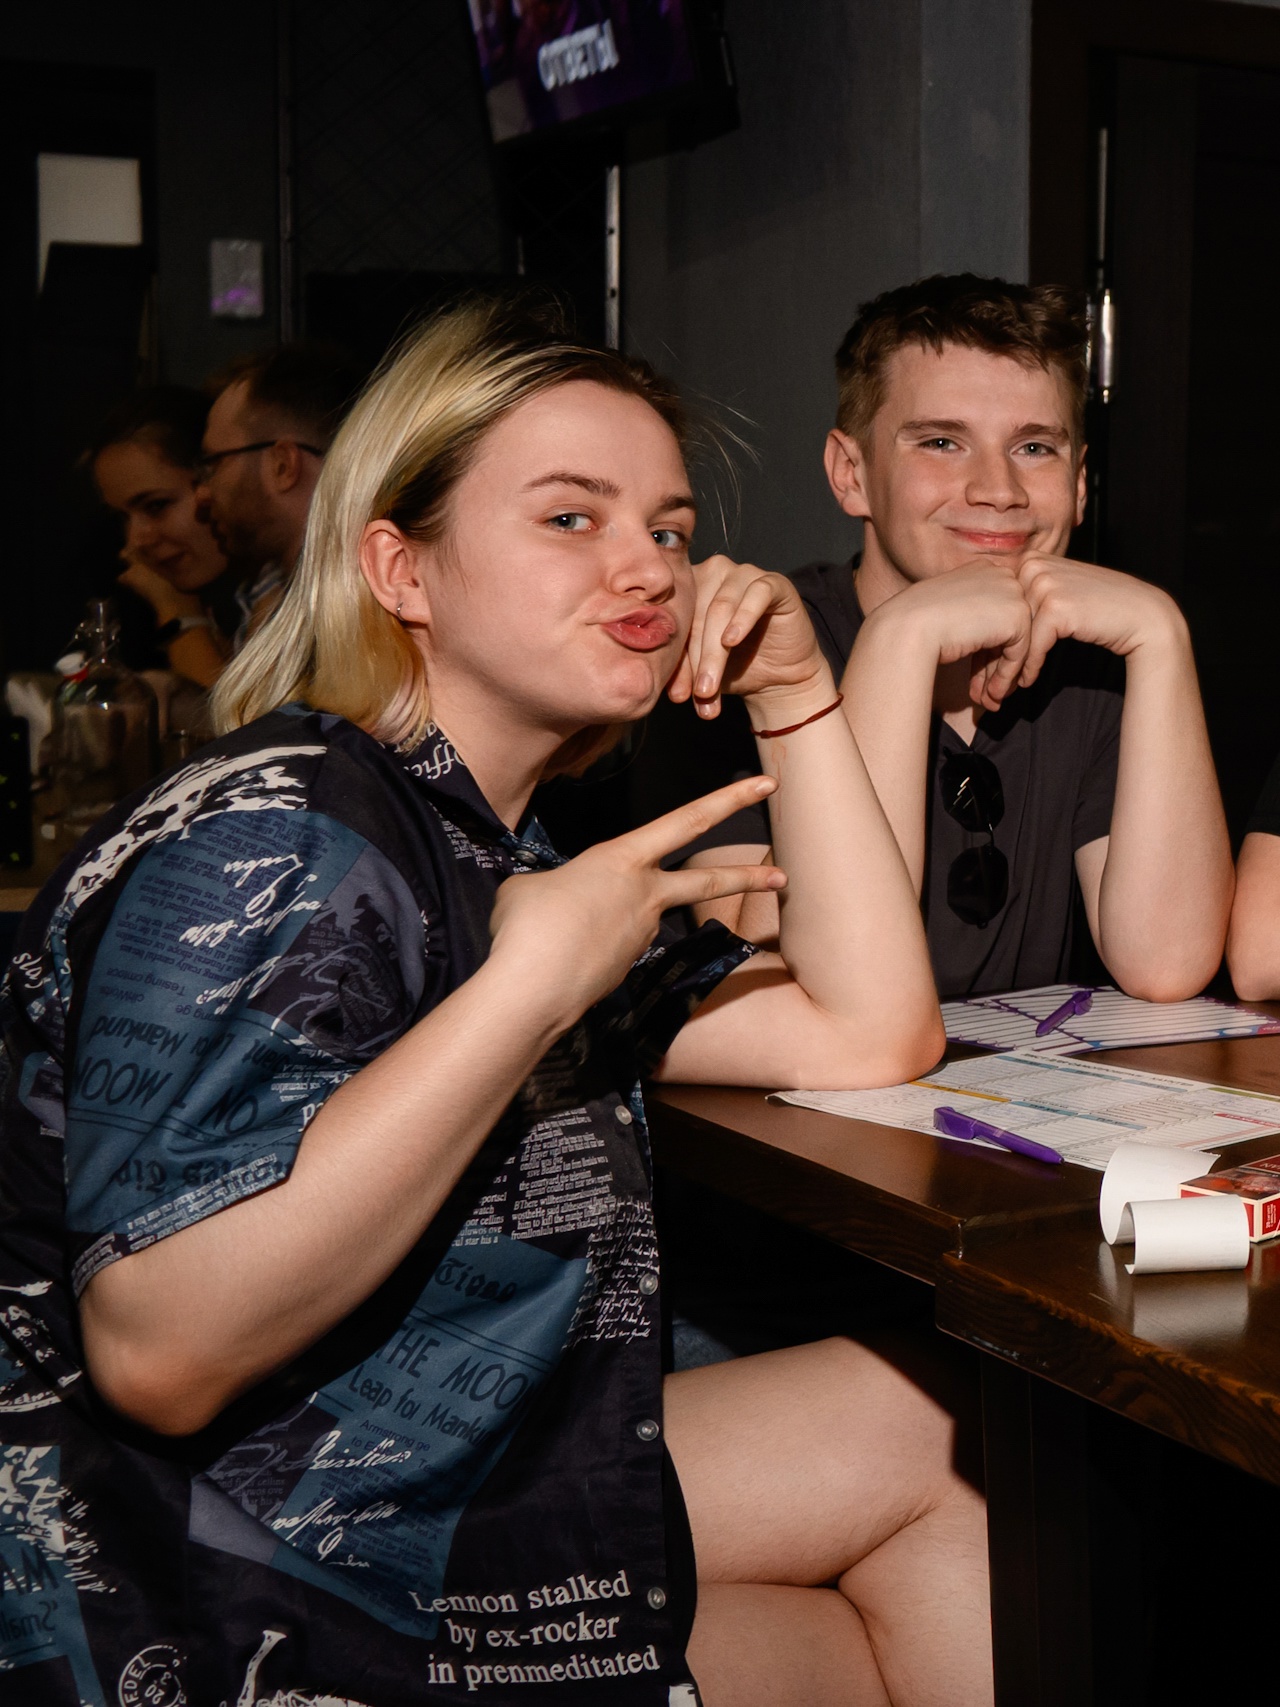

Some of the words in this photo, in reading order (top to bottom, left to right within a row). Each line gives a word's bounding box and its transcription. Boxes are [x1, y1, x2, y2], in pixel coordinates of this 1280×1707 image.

[348, 1364, 393, 1408] Leap
[360, 1419, 416, 1446] Armstrong
[409, 1590, 518, 1616] Lennon
[527, 1571, 632, 1611] stalked
[446, 1617, 478, 1652] by
[486, 1613, 620, 1648] ex-rocker
[427, 1654, 457, 1685] in
[465, 1646, 661, 1688] prenmeditated
